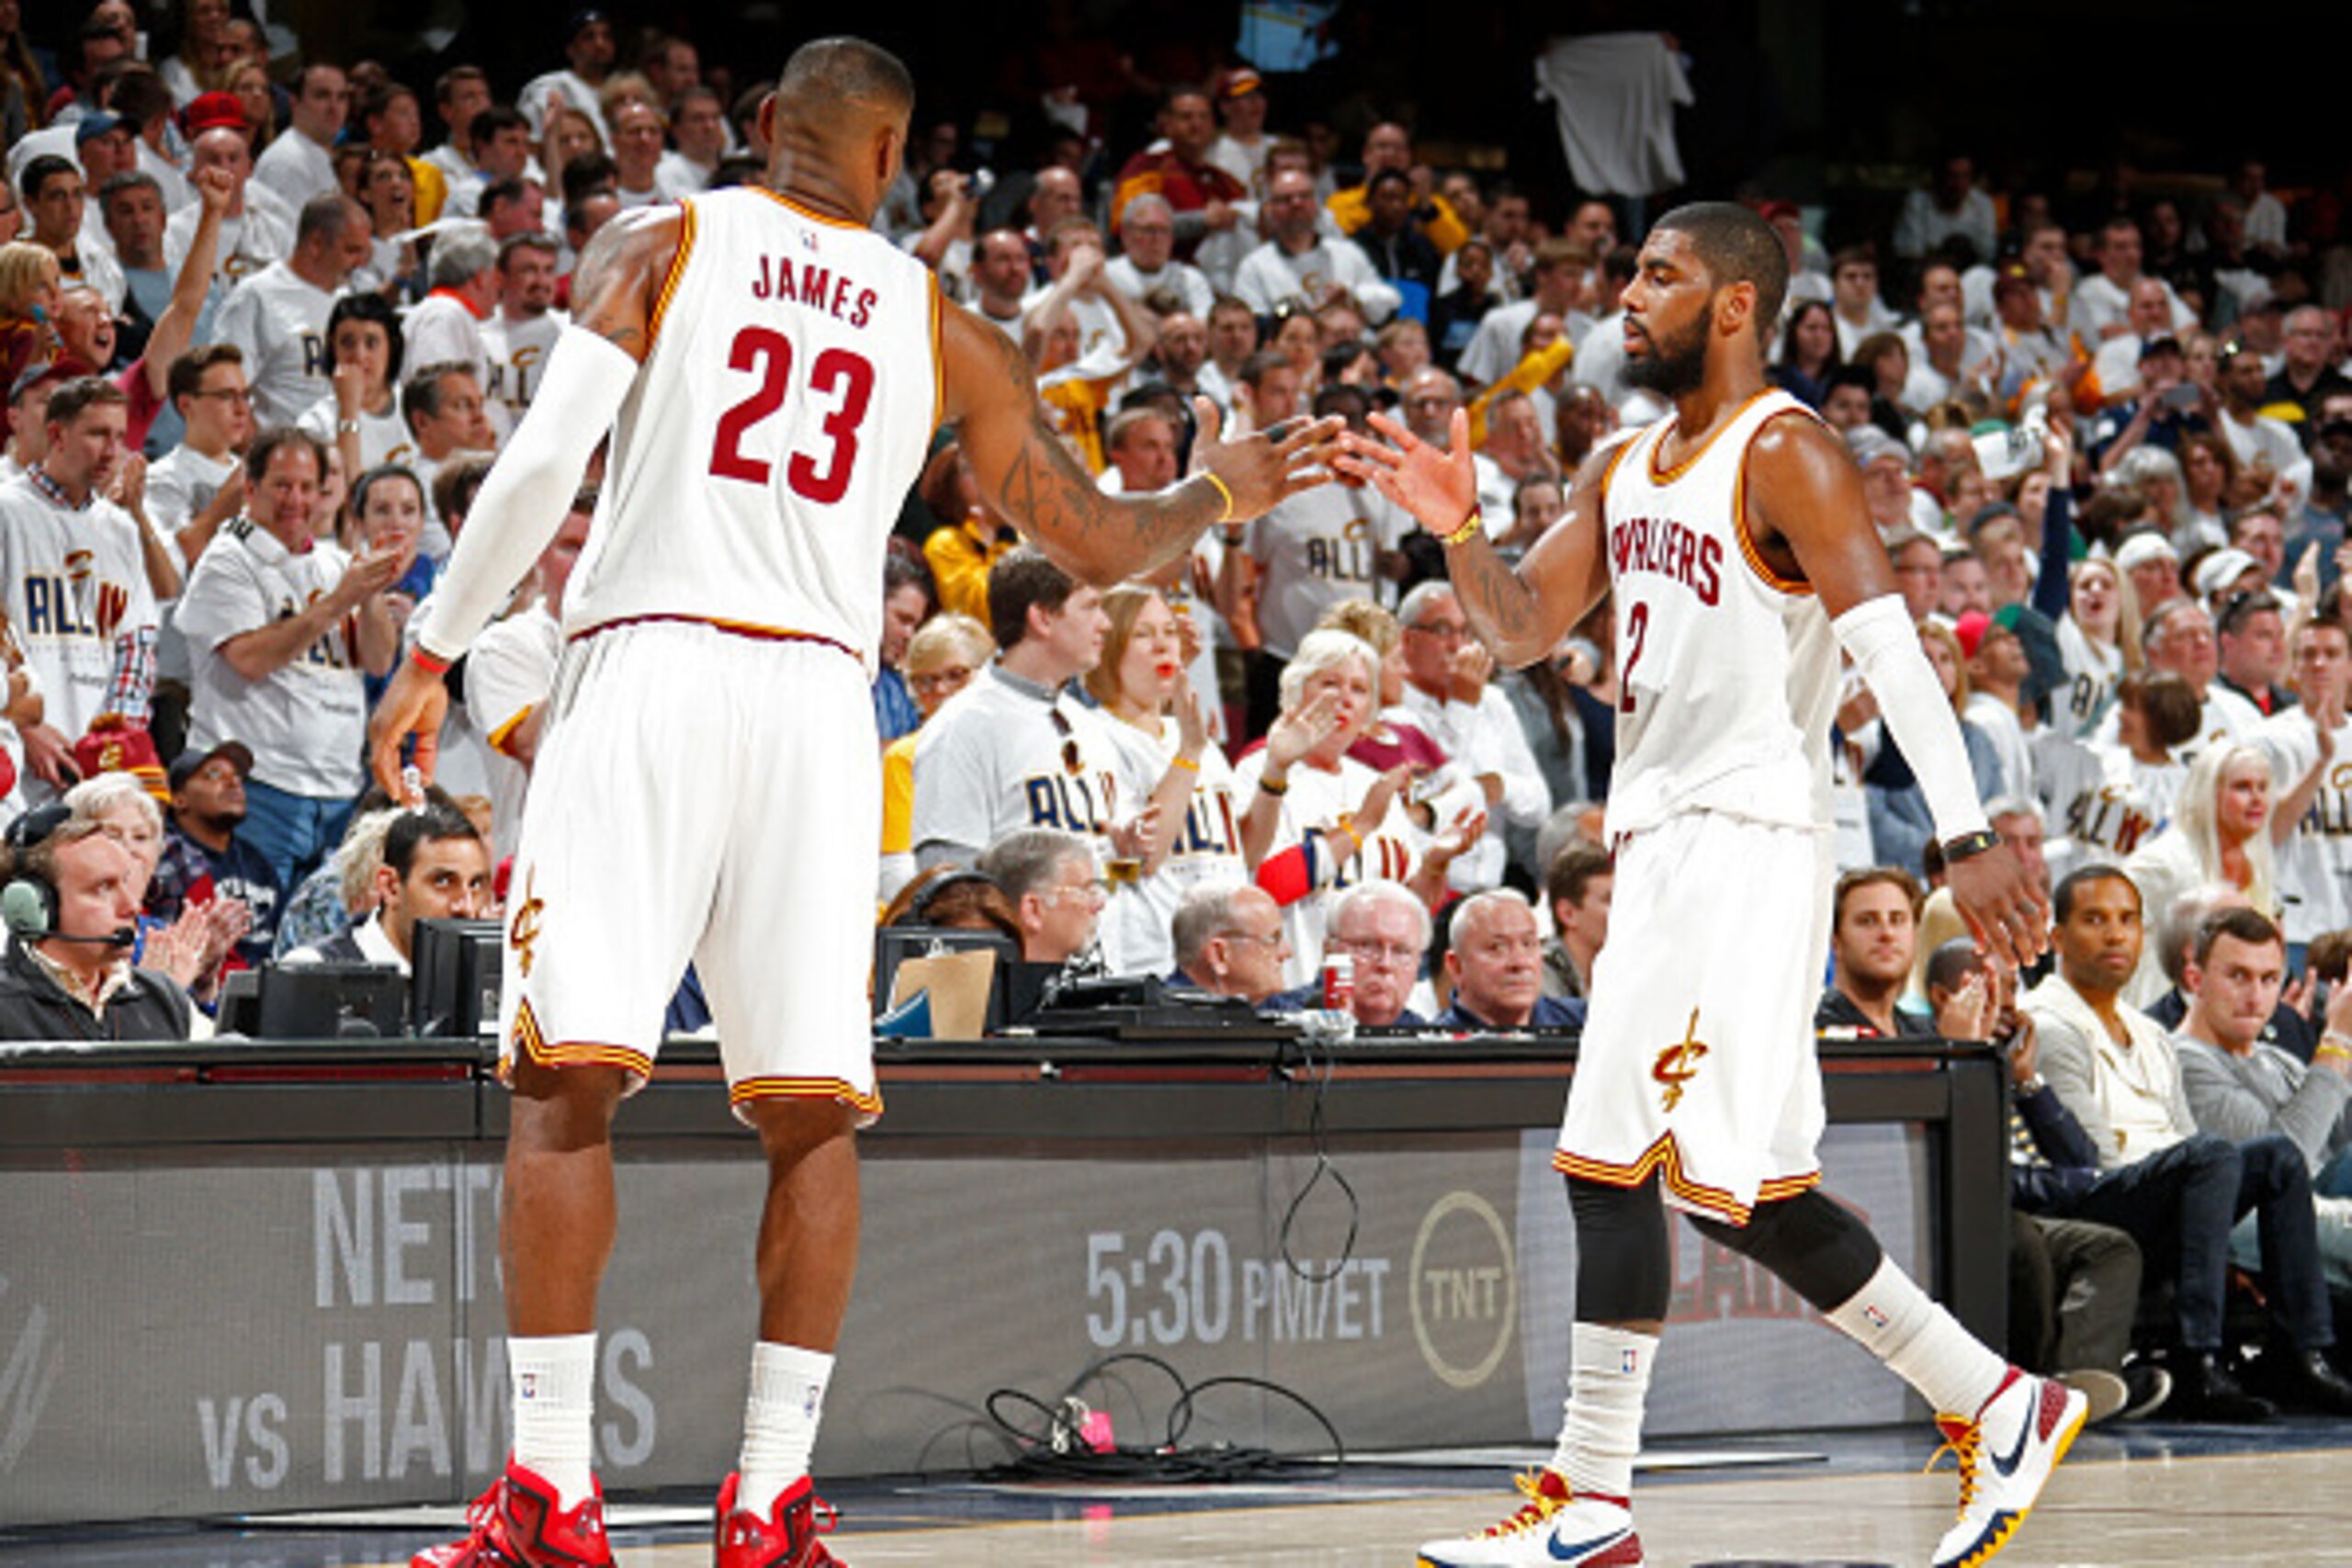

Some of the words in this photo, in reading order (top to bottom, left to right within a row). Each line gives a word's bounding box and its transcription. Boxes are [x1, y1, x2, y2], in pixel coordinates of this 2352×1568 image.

[752, 254, 877, 329] JAMES
[708, 325, 876, 507] 23
[1621, 601, 1648, 713] 2
[312, 1162, 503, 1308] NET
[1087, 1229, 1232, 1348] 5:30
[1243, 1258, 1391, 1342] PM/ET
[1425, 1268, 1501, 1320] TNT
[323, 1328, 656, 1483] HAWS
